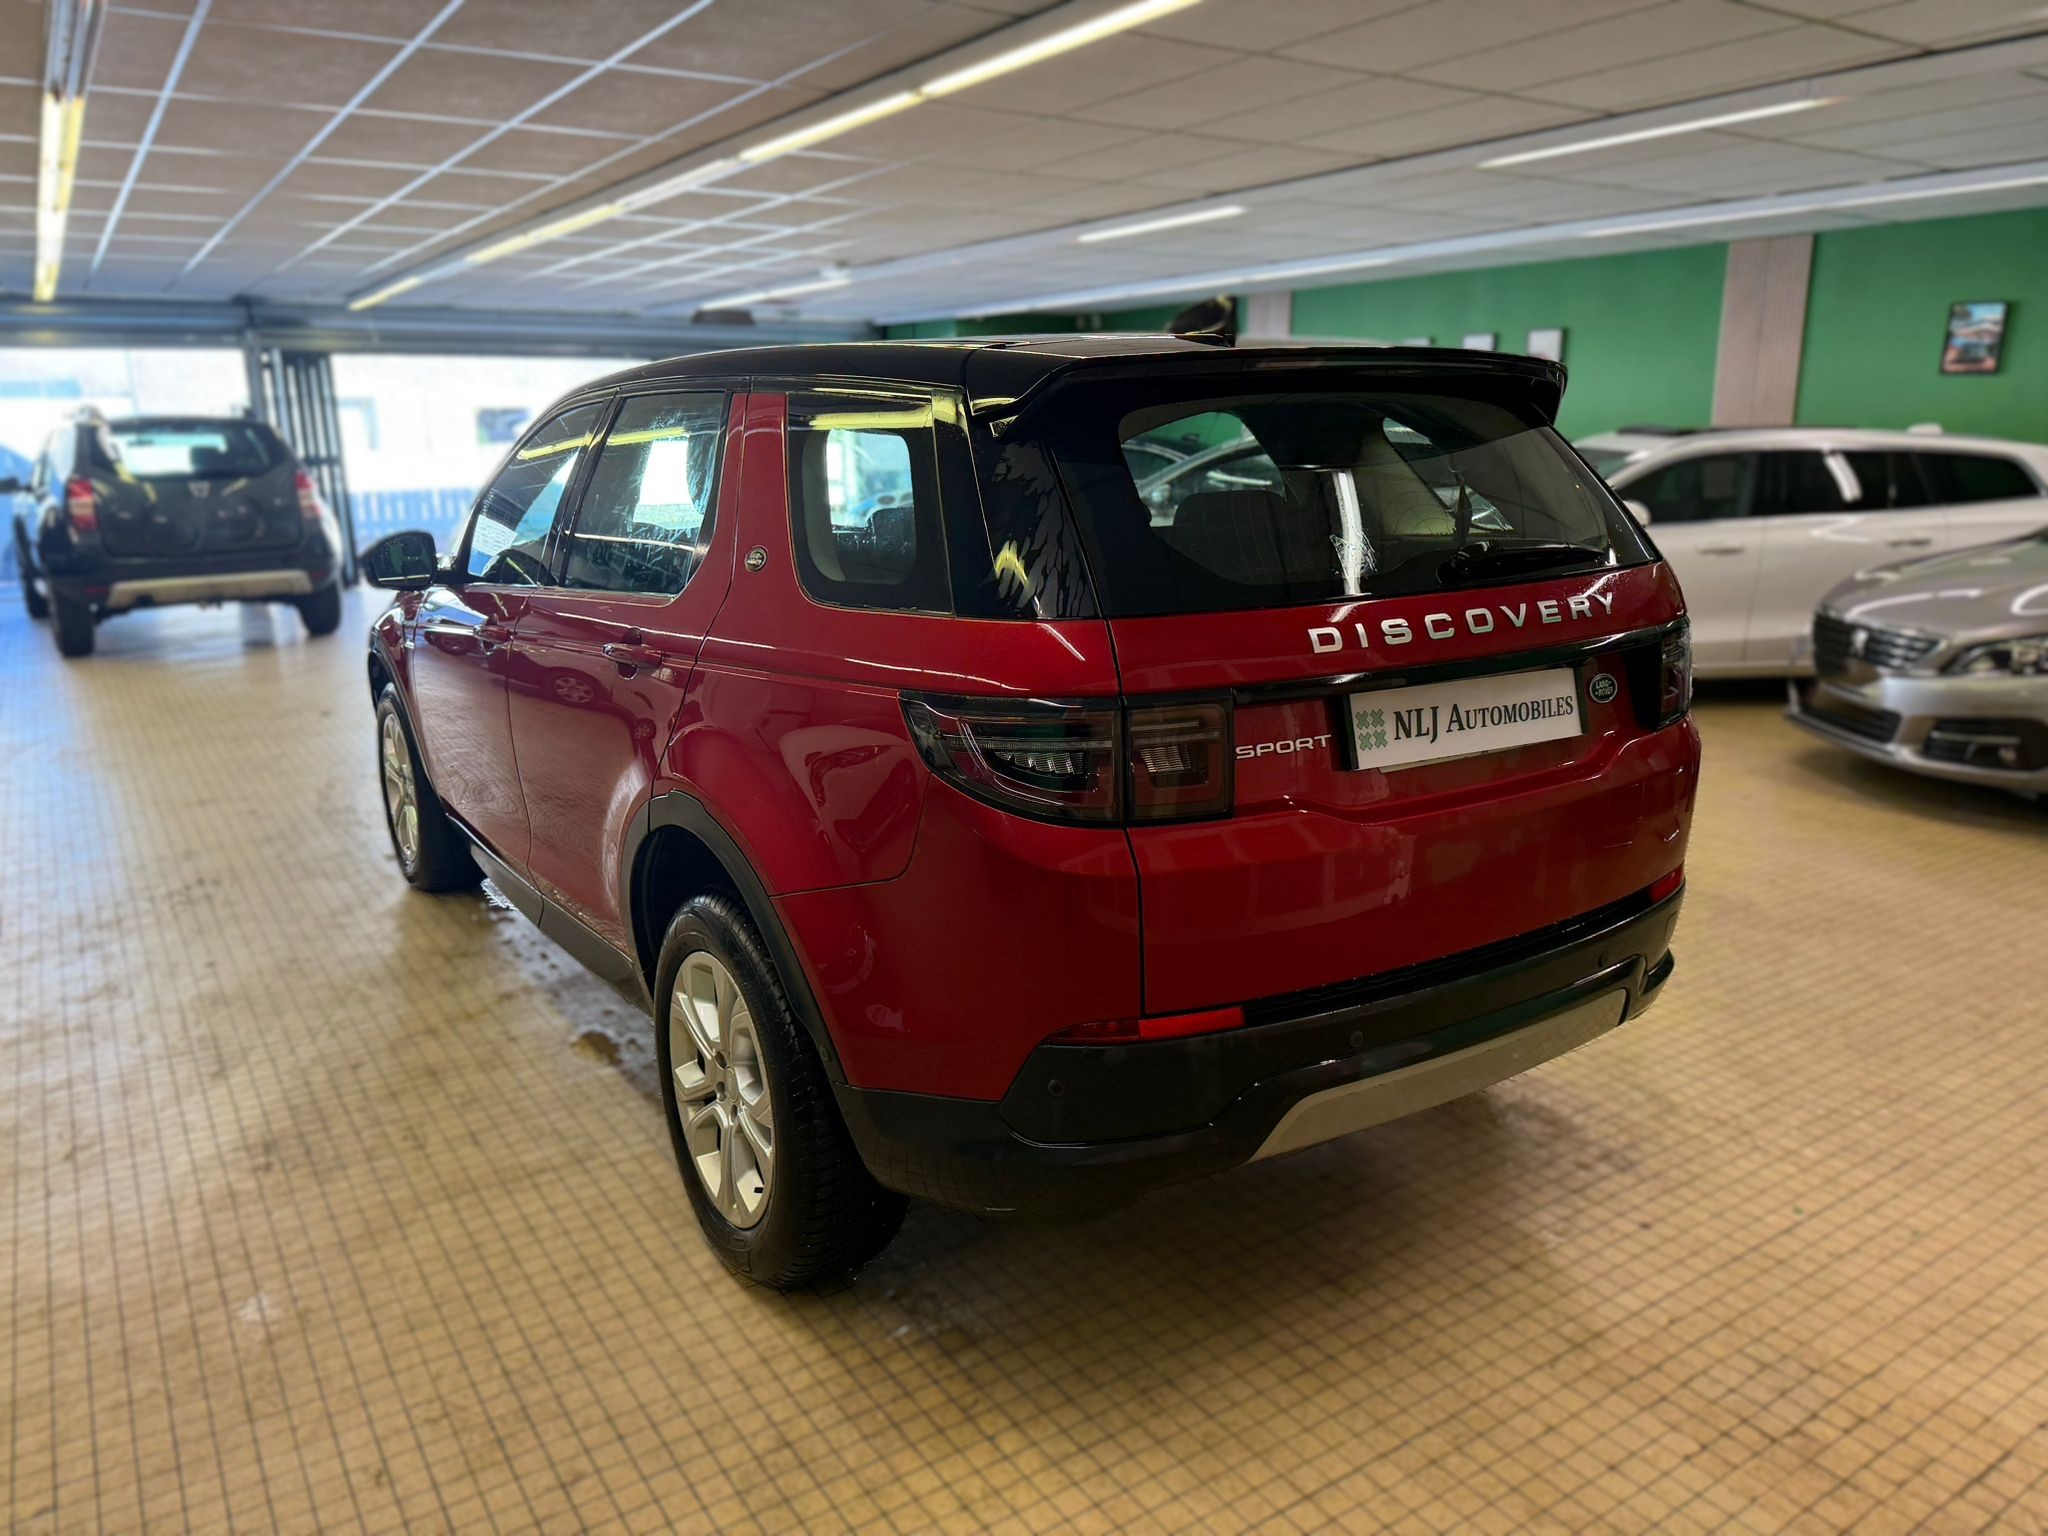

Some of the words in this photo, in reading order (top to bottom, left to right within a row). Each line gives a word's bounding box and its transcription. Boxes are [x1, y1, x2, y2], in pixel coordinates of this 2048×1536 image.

[1307, 591, 1613, 654] DISCOVERY
[1393, 705, 1439, 744] NLJ
[1235, 734, 1332, 760] SPORT
